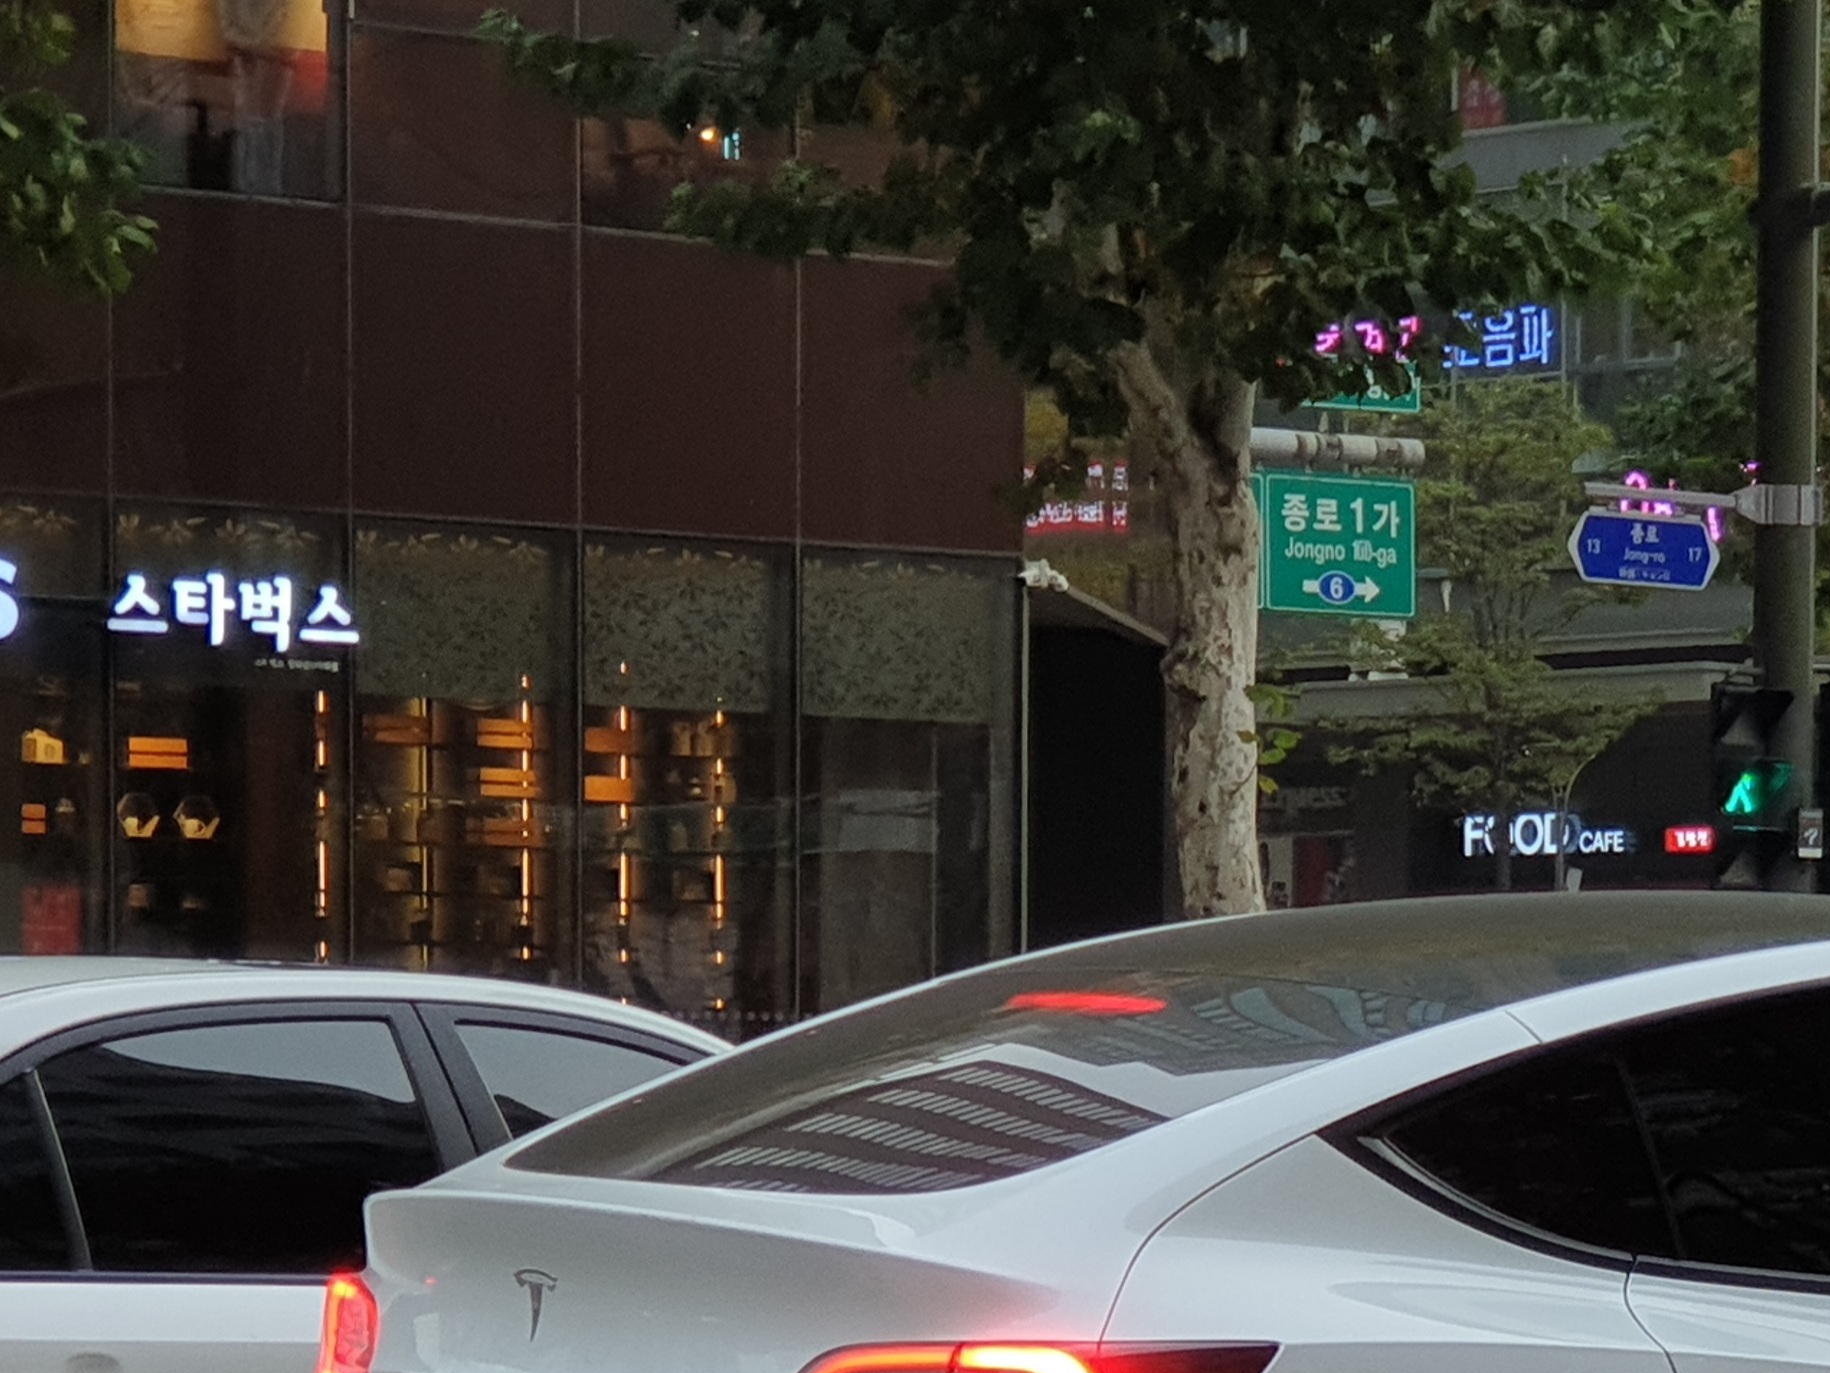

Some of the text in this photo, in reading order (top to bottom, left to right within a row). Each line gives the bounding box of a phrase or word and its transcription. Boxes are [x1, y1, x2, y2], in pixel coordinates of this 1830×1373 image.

[1630, 522, 1660, 545] 종로
[1285, 536, 1345, 565] Jongno
[1587, 539, 1600, 554] 13
[1689, 547, 1701, 562] 17
[1329, 576, 1344, 600] 6
[106, 571, 360, 652] 스타벅스
[1579, 829, 1625, 854] CAFE
